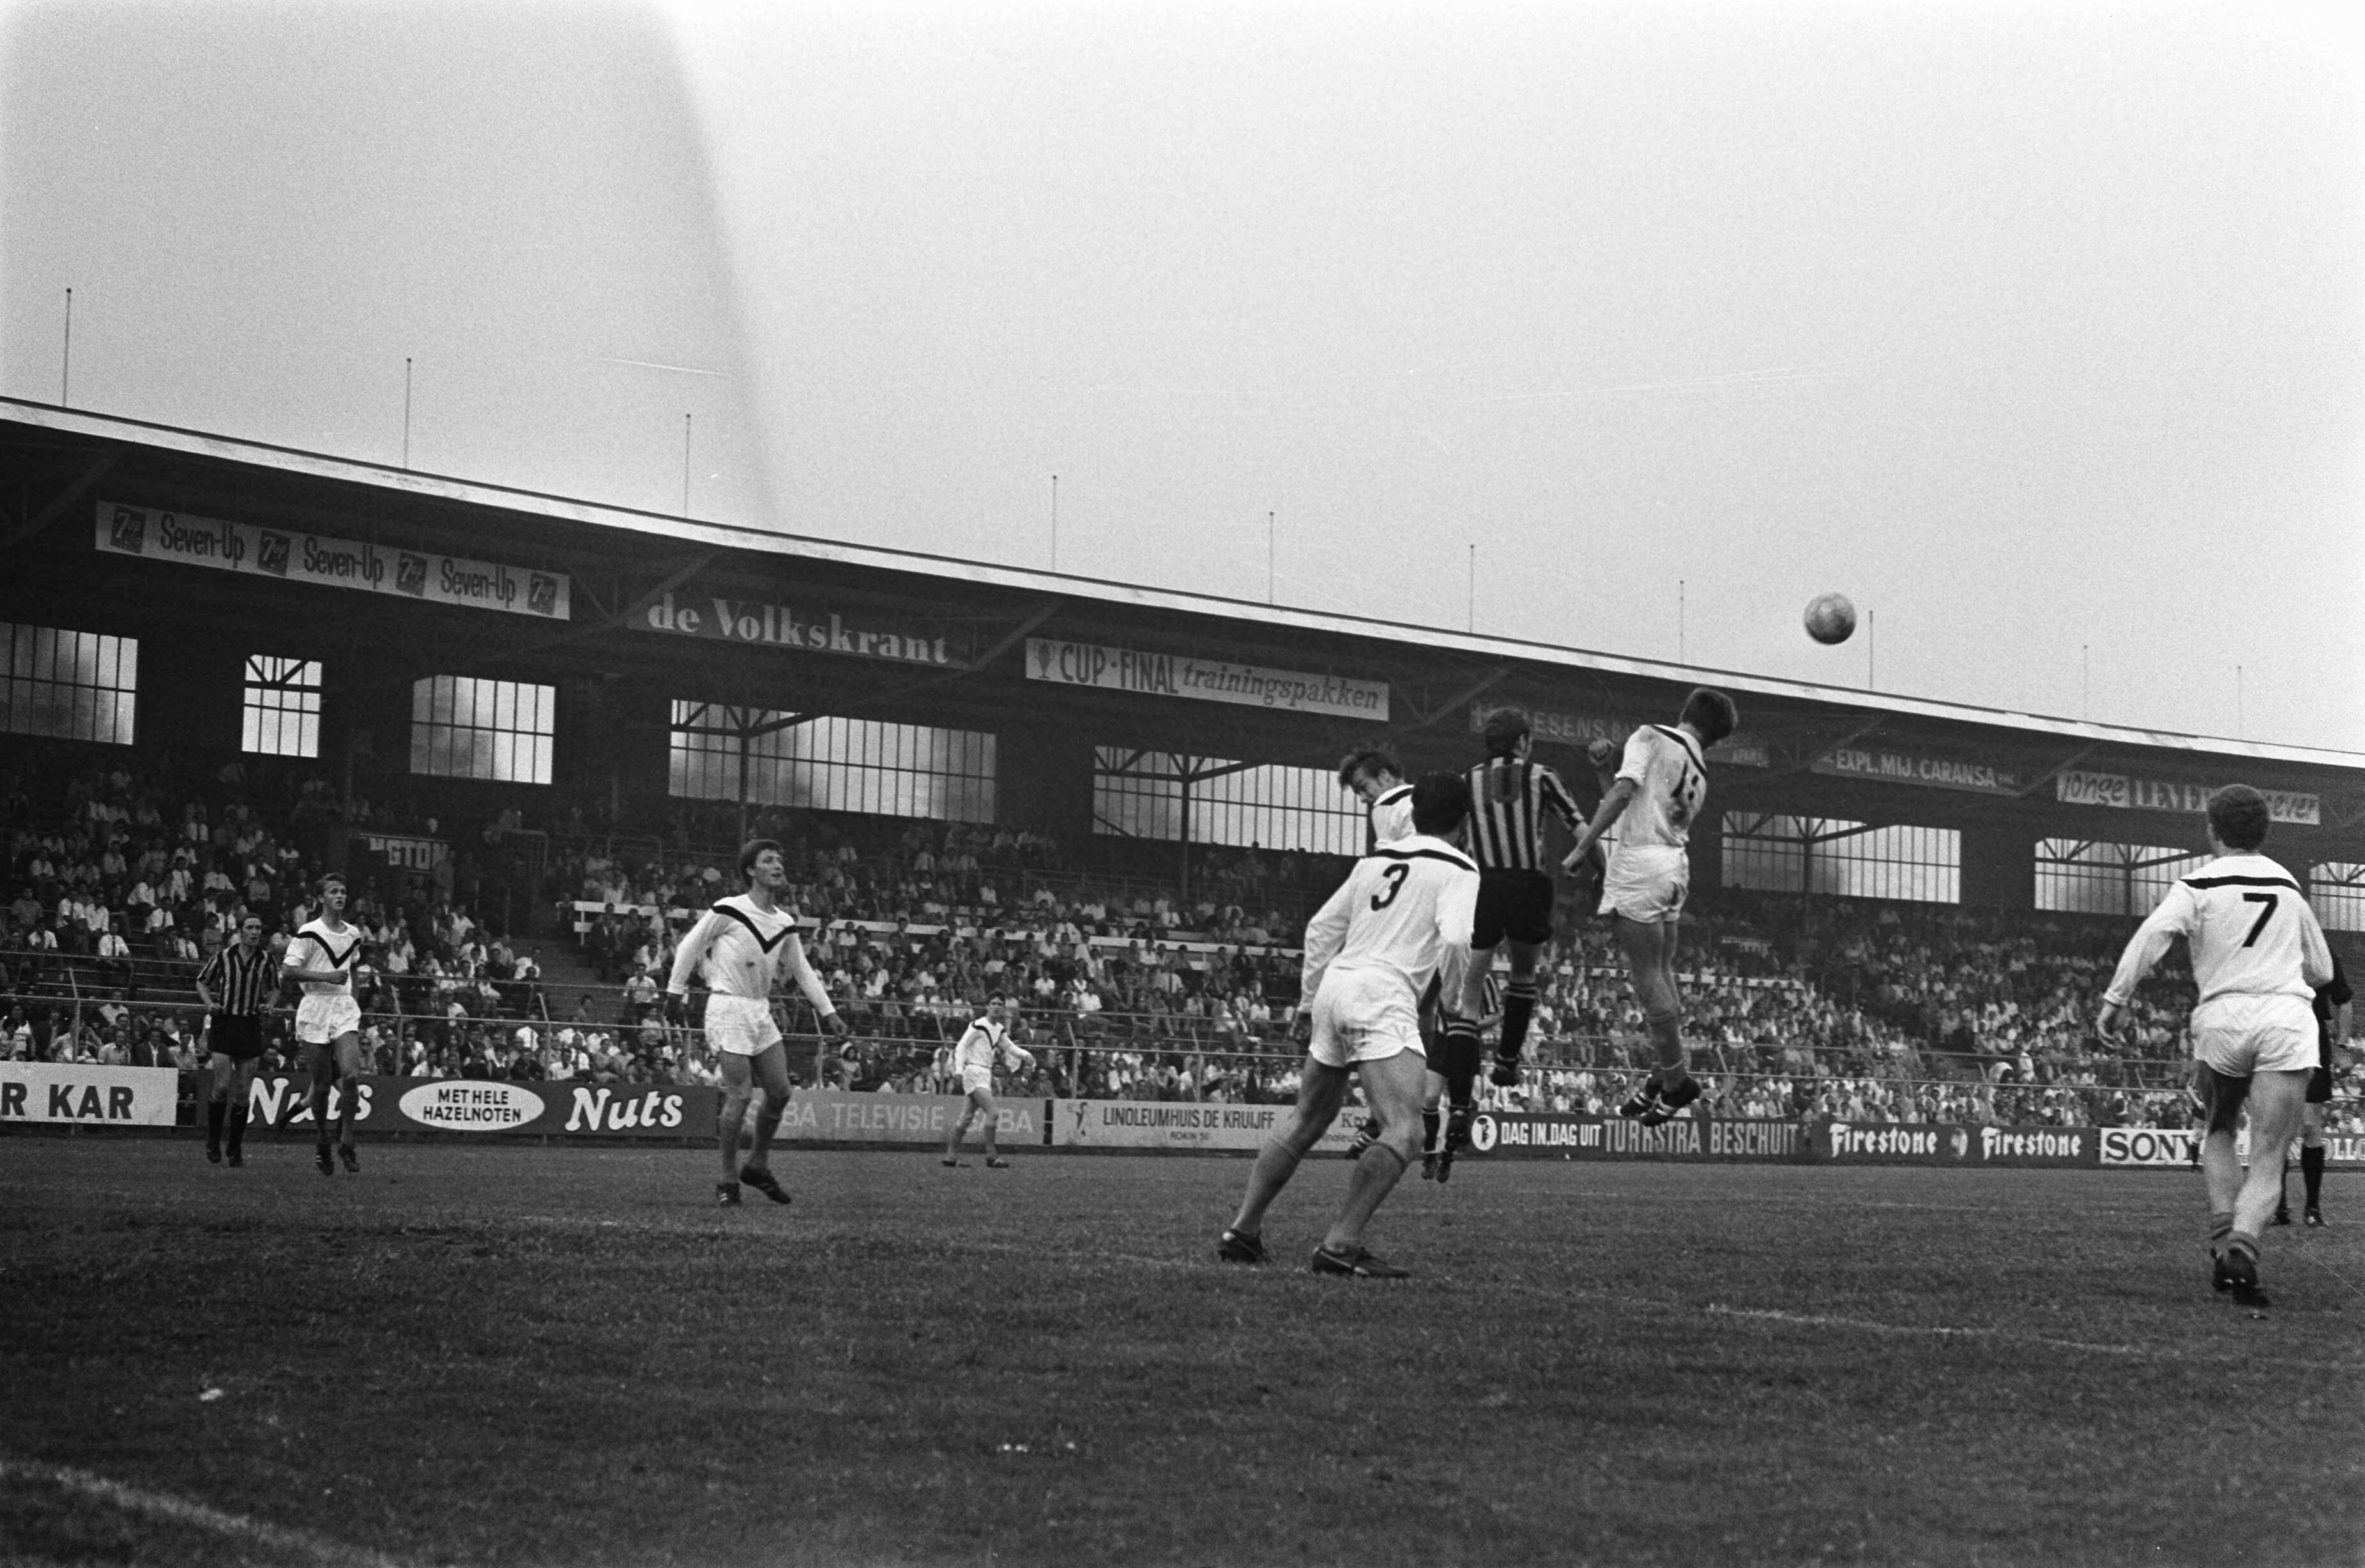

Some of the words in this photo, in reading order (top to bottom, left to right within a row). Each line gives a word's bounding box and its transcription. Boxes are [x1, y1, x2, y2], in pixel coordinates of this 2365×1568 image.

[160, 512, 245, 563] Seven-Up
[303, 537, 384, 589] Seven-Up
[441, 557, 515, 604] Seven-Up
[648, 592, 700, 632] de
[712, 598, 949, 664] Volkskrant
[1183, 660, 1378, 710] trainingspakken
[1920, 759, 1996, 787] CARANSA
[1371, 863, 1410, 911] 3
[2242, 893, 2278, 947] 7
[49, 1084, 134, 1120] KAR
[423, 1106, 521, 1123] HAZELNOTEN
[437, 1088, 469, 1104] MET
[473, 1090, 509, 1105] HELE
[565, 1087, 683, 1132] Nuts
[830, 1102, 944, 1131] TELEVISIE
[1104, 1107, 1200, 1128] LINOLEUMHUIS
[1204, 1109, 1219, 1129] DE
[1224, 1110, 1274, 1130] KRUIJFF
[1502, 1122, 1528, 1145] DAG
[1581, 1124, 1602, 1147] UIT
[1604, 1119, 1701, 1153] TURKSTRA
[1710, 1122, 1798, 1155] BESCHUIT
[1829, 1123, 1938, 1158] Firestone
[1981, 1127, 2081, 1160] Firestone
